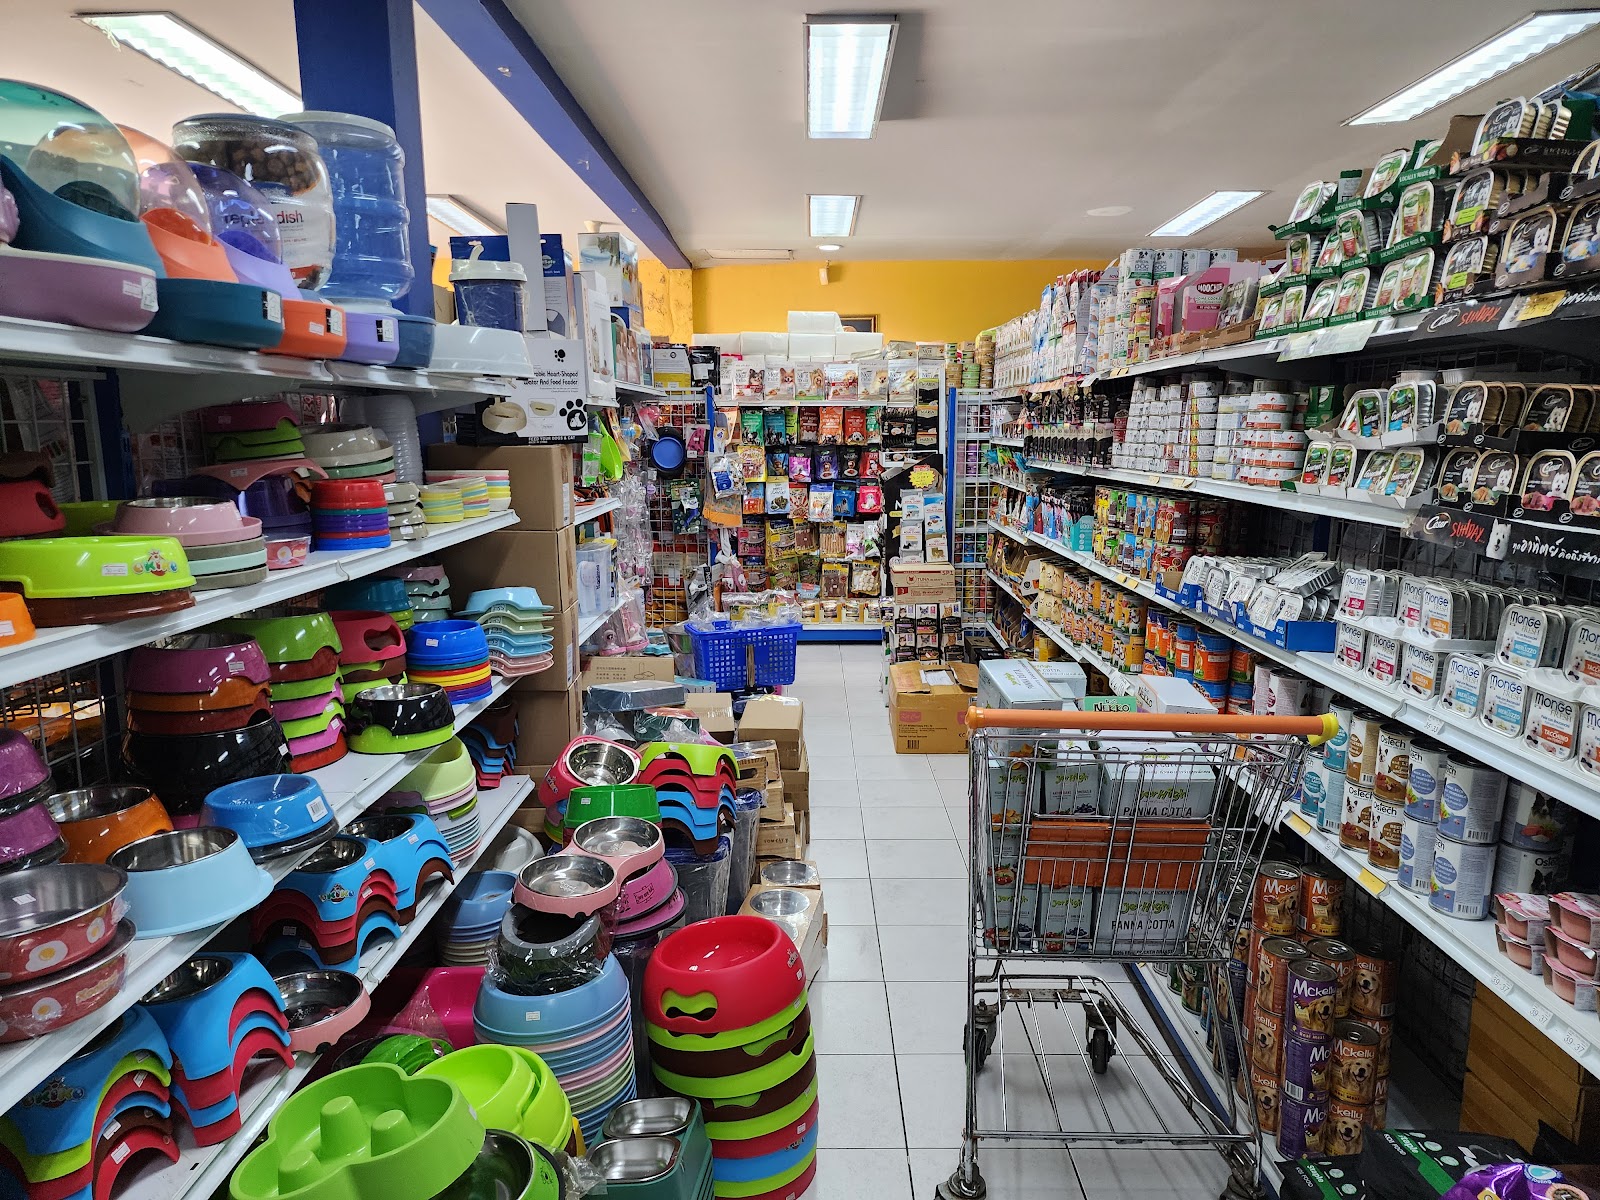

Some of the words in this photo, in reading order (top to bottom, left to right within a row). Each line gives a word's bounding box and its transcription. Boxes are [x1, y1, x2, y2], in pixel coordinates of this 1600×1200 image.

[1510, 610, 1541, 629] Monge
[1373, 634, 1396, 651] Monge
[1408, 644, 1435, 664] Monge
[1451, 660, 1480, 679] Monge
[1490, 674, 1523, 695] Monge
[1535, 691, 1573, 716] Monge
[1380, 734, 1406, 749] Ostech
[1373, 801, 1398, 817] Ostech
[1529, 1006, 1548, 1024] 39-37
[1563, 1034, 1585, 1053] 39-37
[1330, 1103, 1364, 1121] ckelly
